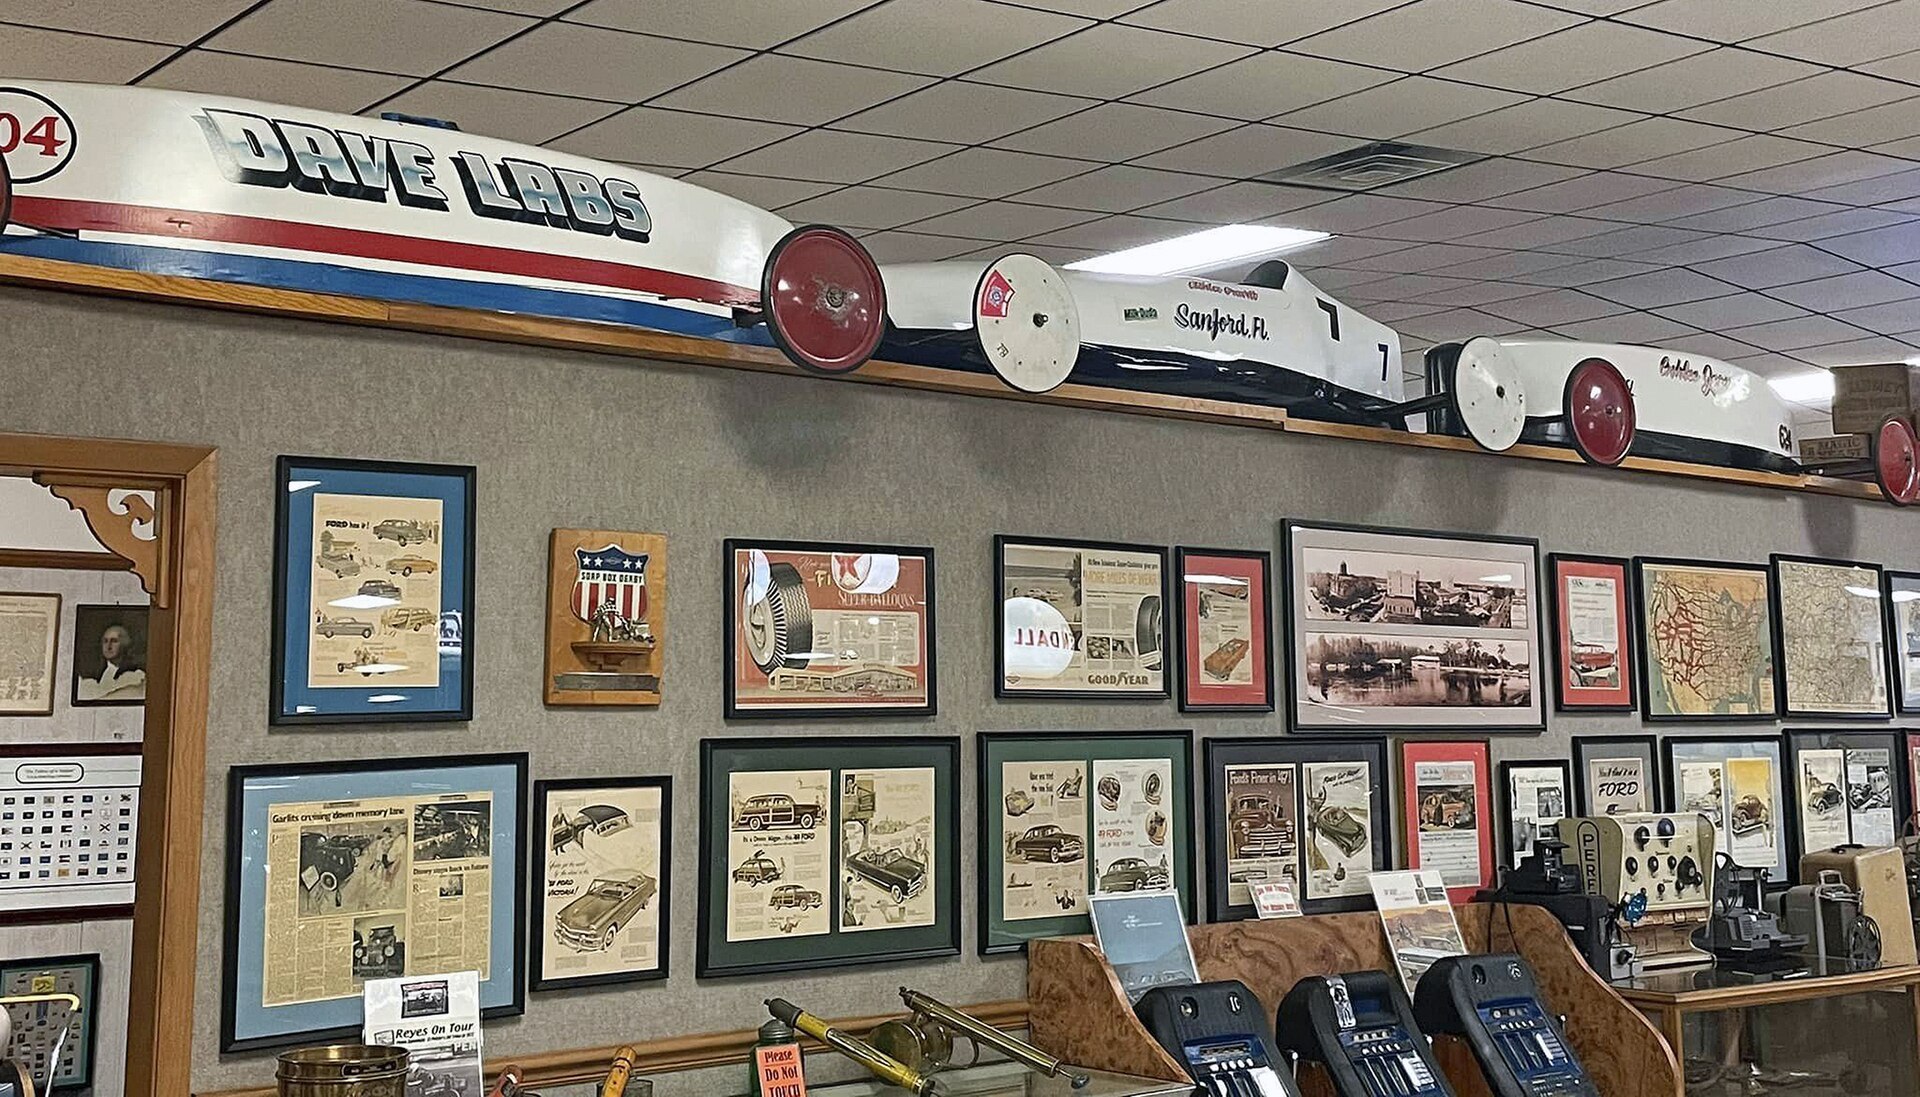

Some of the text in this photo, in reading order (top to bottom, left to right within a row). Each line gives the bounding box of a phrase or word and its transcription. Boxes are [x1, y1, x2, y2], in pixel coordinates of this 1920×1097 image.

[194, 107, 652, 244] DAVE LABS
[1315, 297, 1341, 342] 7
[1377, 343, 1389, 382] 7
[325, 520, 349, 529] FORD
[580, 571, 643, 584] SOAP BOX DERBY
[1598, 781, 1639, 797] FORD
[272, 807, 405, 824] Garlits cruising down memory lane
[1582, 833, 1597, 895] PERF
[395, 1027, 428, 1039] Reyes
[431, 1024, 446, 1036] On
[449, 1022, 475, 1033] Tour
[764, 1050, 794, 1064] Please
[764, 1068, 780, 1082] Do
[768, 1083, 801, 1097] TOUCH
